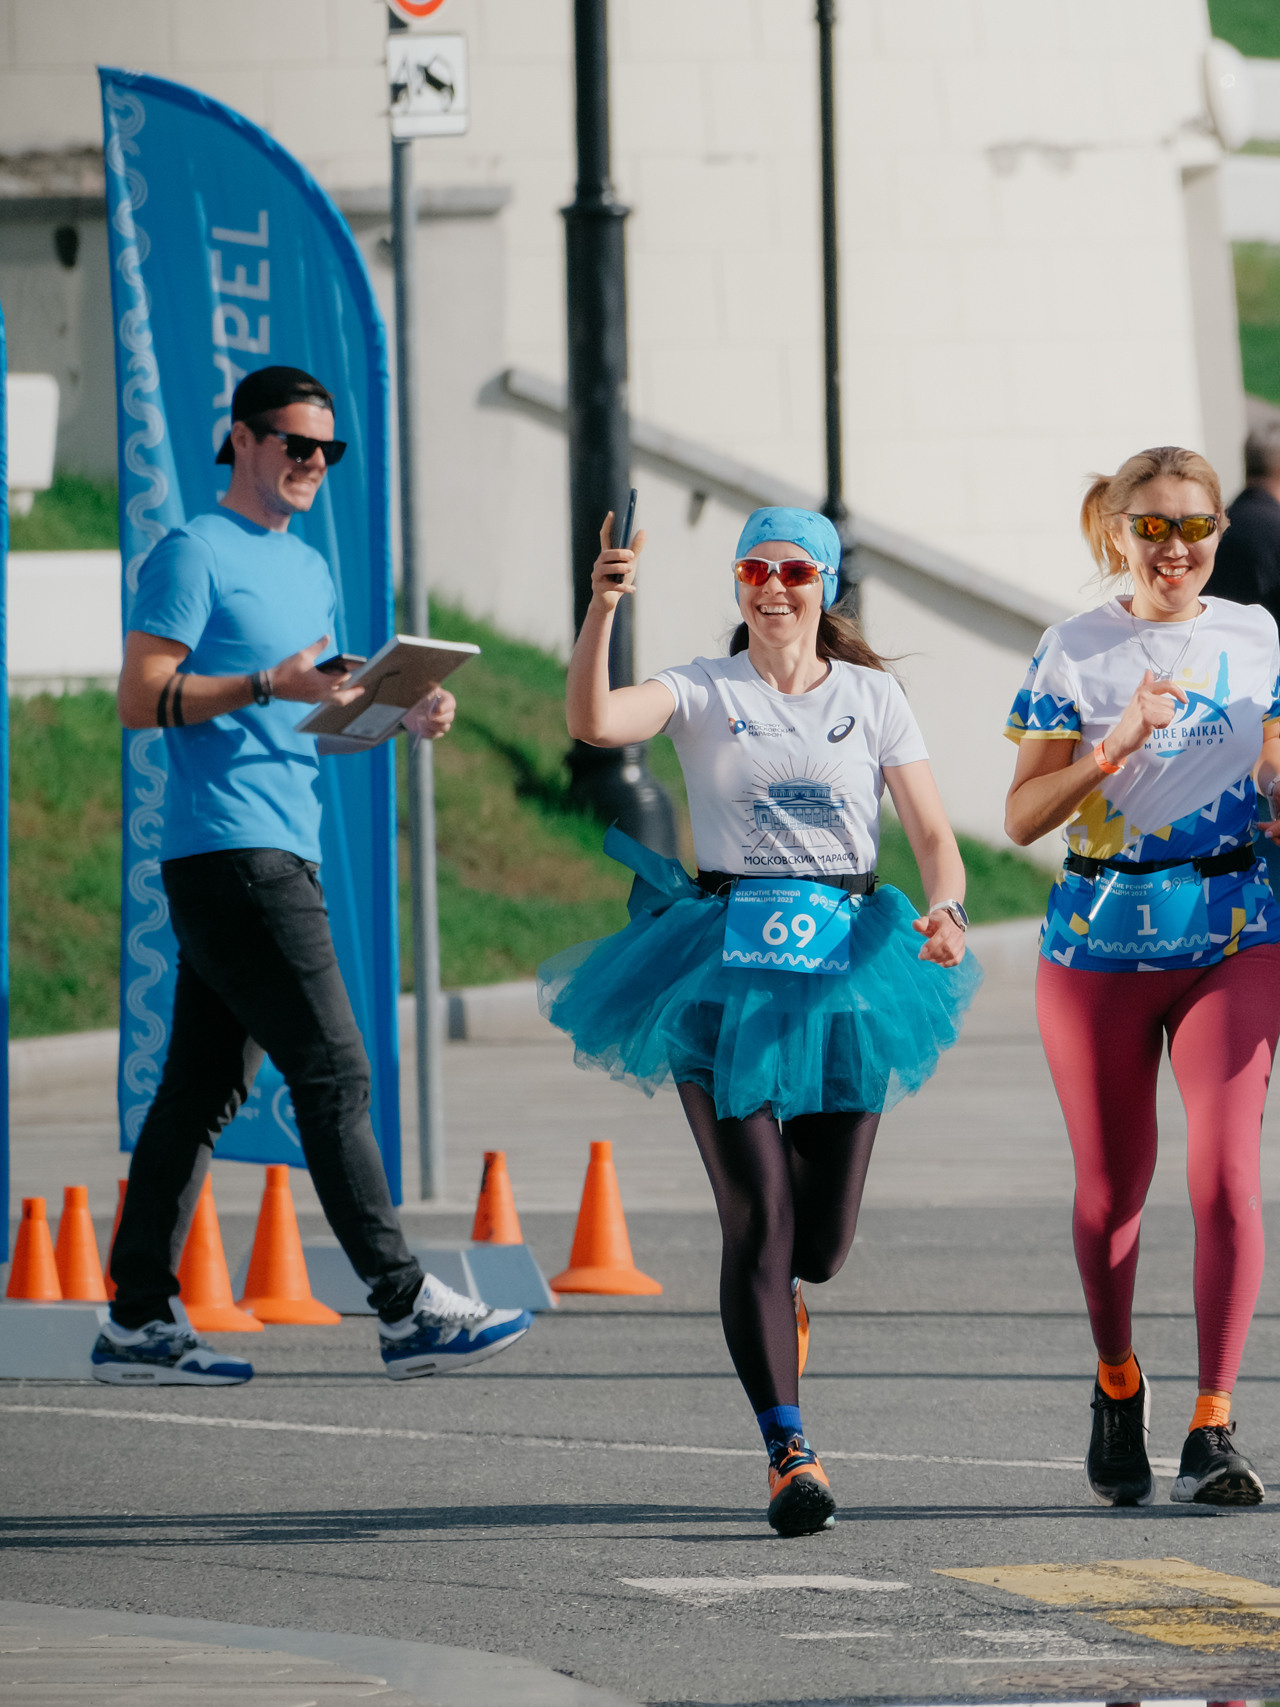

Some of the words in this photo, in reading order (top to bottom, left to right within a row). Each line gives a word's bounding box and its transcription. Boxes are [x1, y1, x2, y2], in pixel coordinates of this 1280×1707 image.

[1152, 727, 1177, 740] URE
[1181, 724, 1225, 738] BAIKAL
[1144, 738, 1224, 750] MARATHON
[735, 889, 771, 897] ОТКРЫТИЕ
[772, 888, 801, 897] РЕЧНОЙ
[1136, 904, 1158, 936] 1
[762, 911, 817, 949] 69
